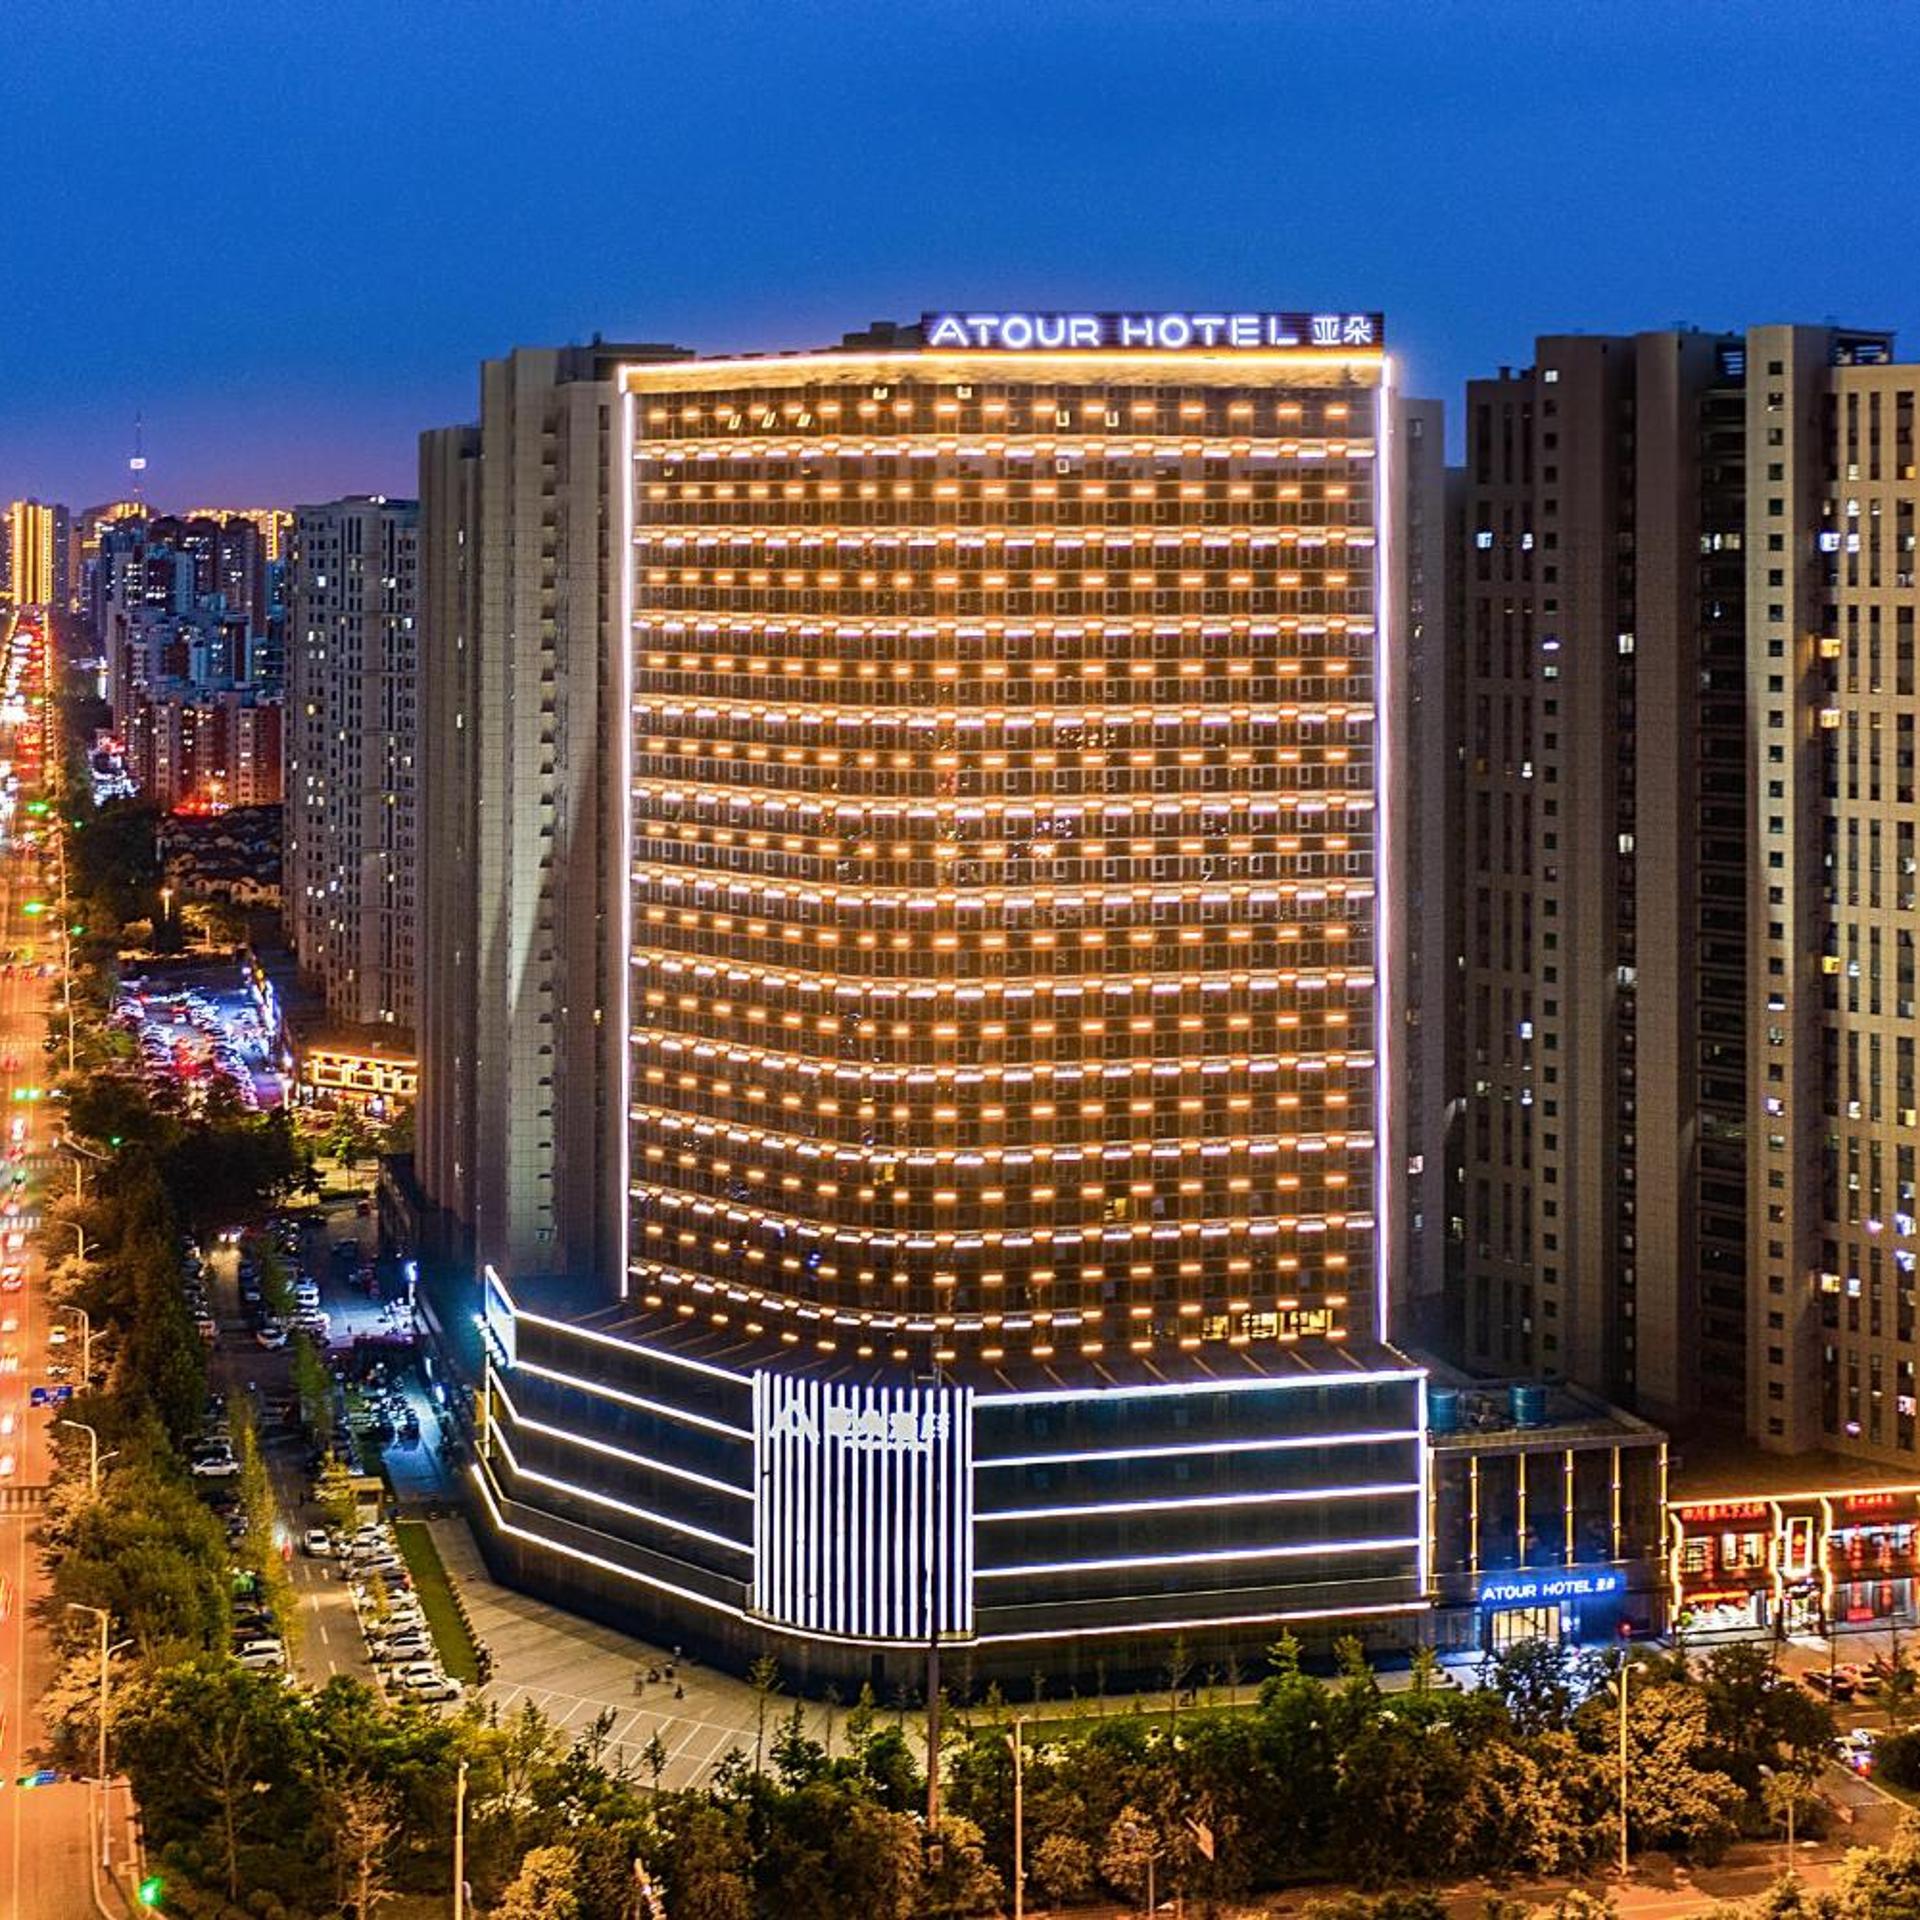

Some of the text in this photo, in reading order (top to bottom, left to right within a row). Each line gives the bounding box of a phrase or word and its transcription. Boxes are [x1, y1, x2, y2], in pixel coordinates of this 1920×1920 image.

[930, 317, 1299, 348] ATOUR HOTEL
[1311, 316, 1372, 345] 亚朵
[1482, 1584, 1537, 1601] ATOUR
[1543, 1579, 1593, 1596] HOTEL
